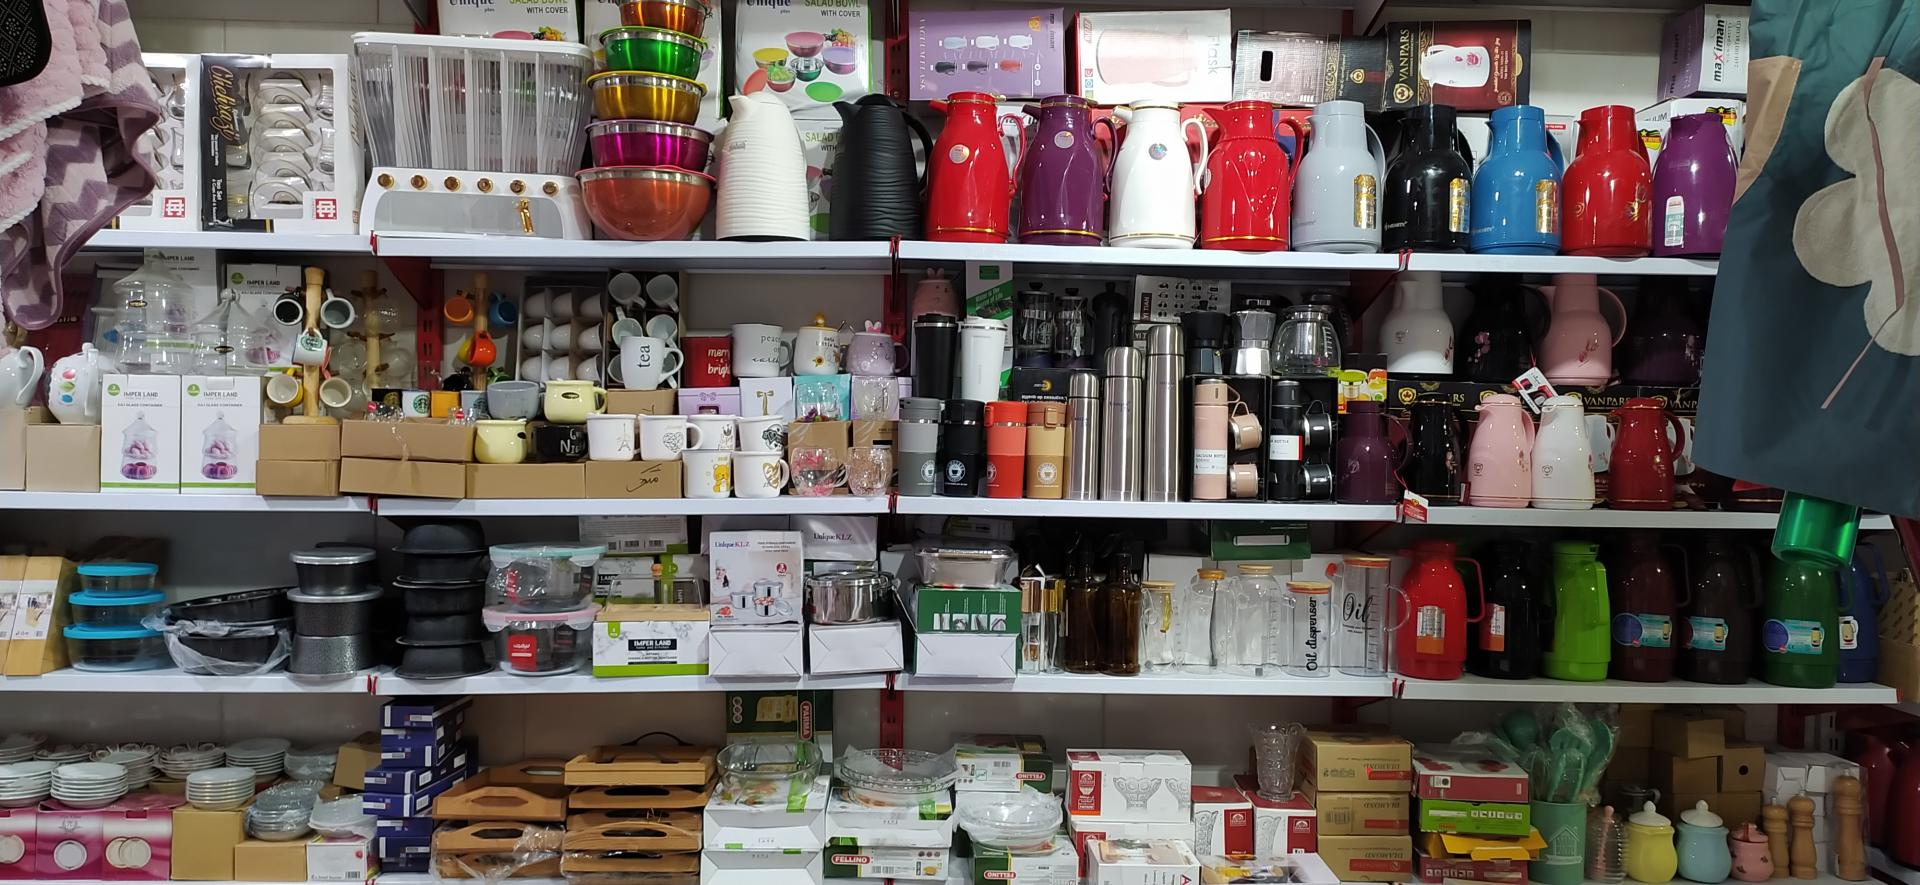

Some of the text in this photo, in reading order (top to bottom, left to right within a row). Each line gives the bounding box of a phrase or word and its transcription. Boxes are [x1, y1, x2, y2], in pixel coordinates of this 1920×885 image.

[1399, 28, 1410, 82] VANPARS
[1713, 19, 1725, 82] maximan
[805, 132, 833, 142] SALAD
[637, 344, 650, 369] tea
[1669, 399, 1698, 409] VANP
[1343, 592, 1374, 623] Oil
[1305, 597, 1321, 672] Oil dispenser
